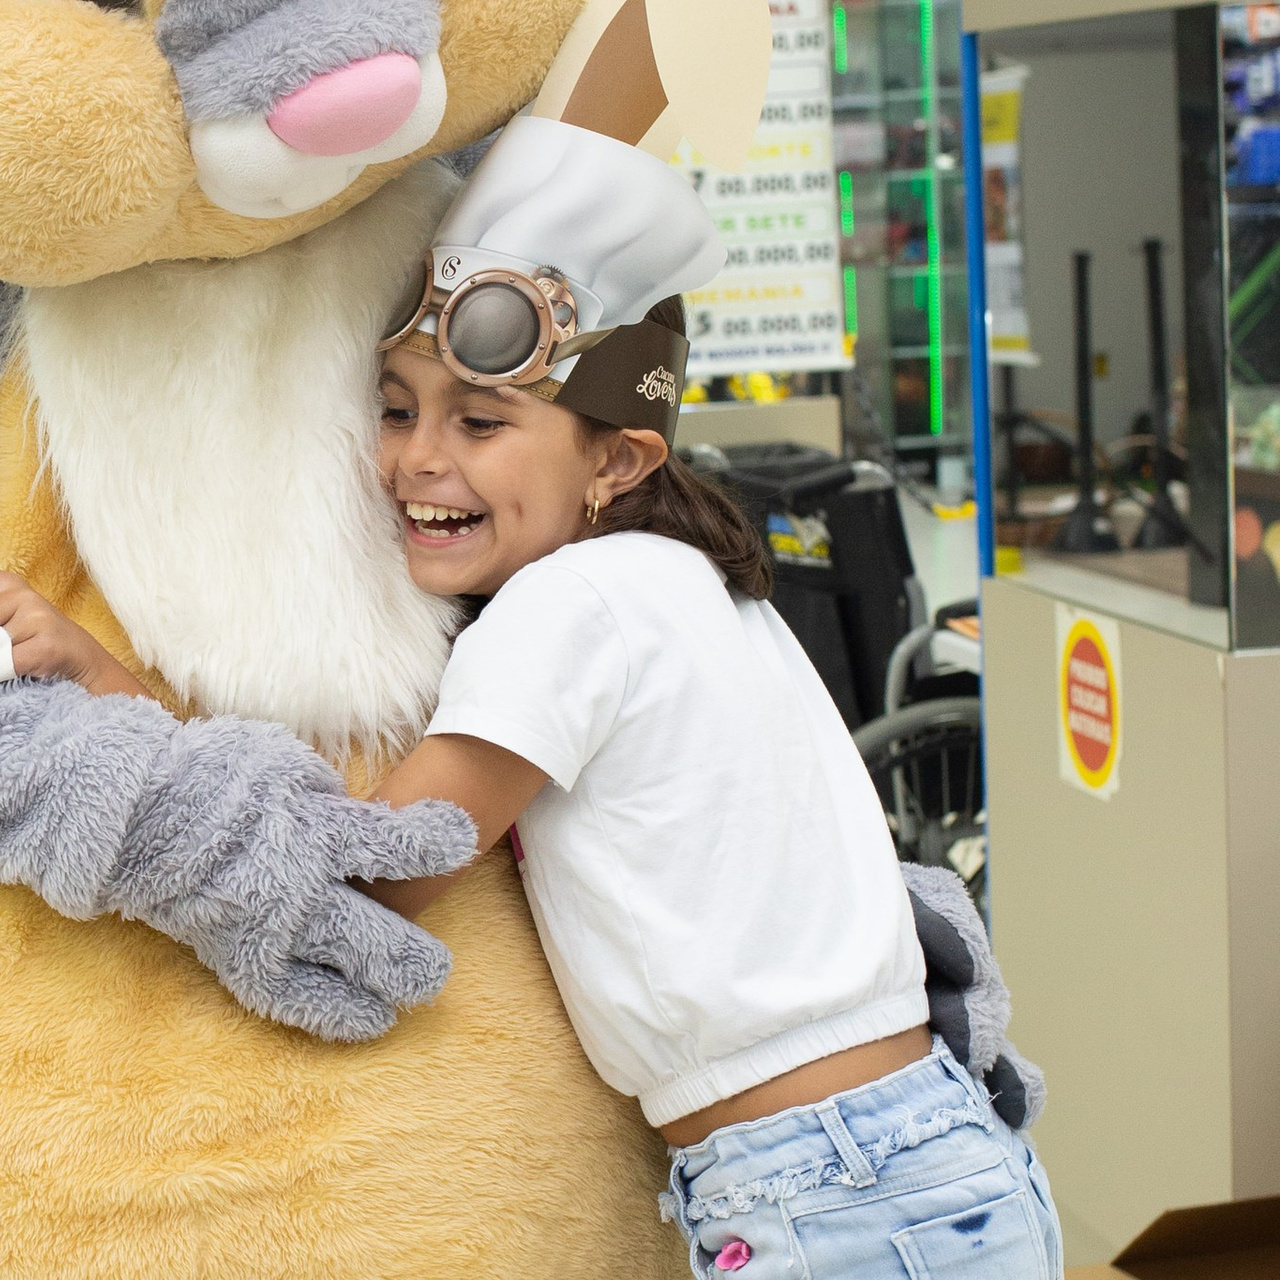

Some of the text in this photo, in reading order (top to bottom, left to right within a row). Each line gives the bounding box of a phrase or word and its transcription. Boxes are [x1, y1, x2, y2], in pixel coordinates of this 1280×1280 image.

[747, 213, 807, 231] SETE
[685, 283, 804, 304] MEMANIA
[636, 370, 677, 408] Lovers
